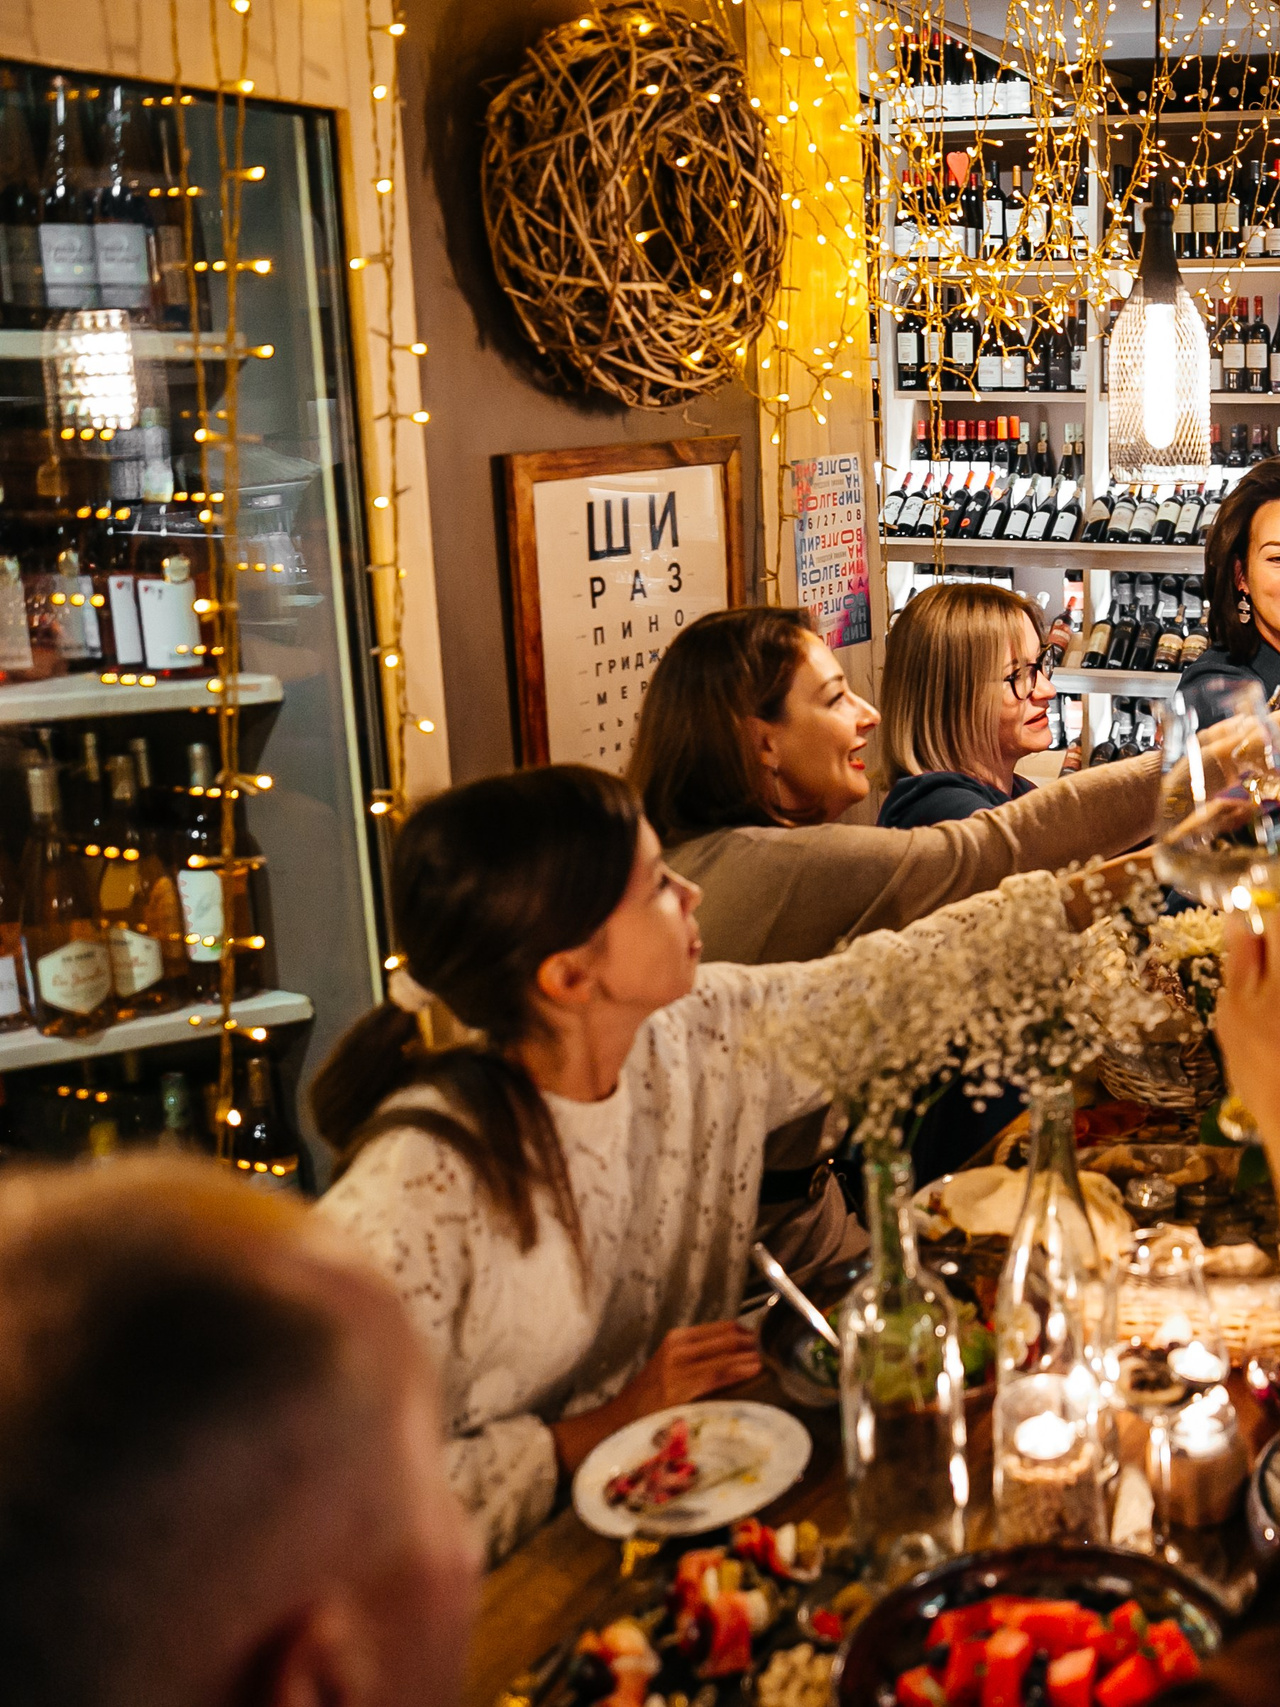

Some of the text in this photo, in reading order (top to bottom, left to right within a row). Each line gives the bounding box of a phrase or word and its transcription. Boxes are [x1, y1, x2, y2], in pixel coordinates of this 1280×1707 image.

[797, 492, 838, 514] ВОЛГЕ
[839, 489, 861, 506] ПИР
[587, 491, 679, 561] ШИ
[800, 535, 821, 555] ПИР
[821, 528, 863, 550] ВОЛГЕ
[800, 553, 815, 571] НА
[847, 544, 863, 560] НА
[590, 562, 683, 609] РАЗ
[801, 564, 840, 587] ВОЛГЕ
[803, 576, 865, 602] СТРЕЛКА
[593, 609, 684, 646] ПИНО
[595, 646, 669, 677] ГРИДЖ
[597, 681, 648, 706] МЕР
